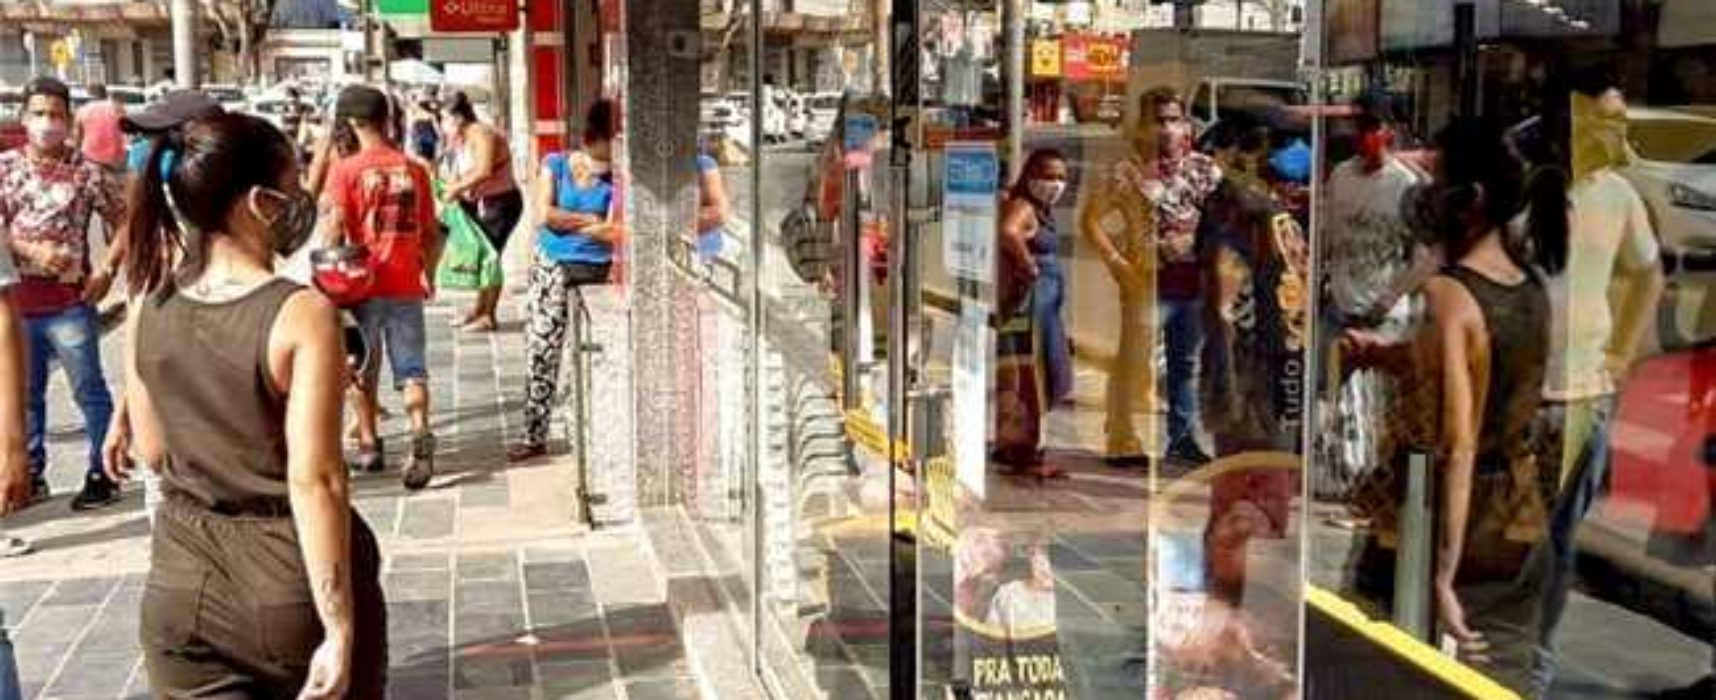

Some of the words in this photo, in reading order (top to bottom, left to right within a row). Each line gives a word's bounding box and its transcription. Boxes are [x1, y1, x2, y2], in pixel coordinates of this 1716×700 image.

[1280, 359, 1300, 433] Tudo
[973, 656, 1012, 688] PRA
[1015, 654, 1065, 685] TODA
